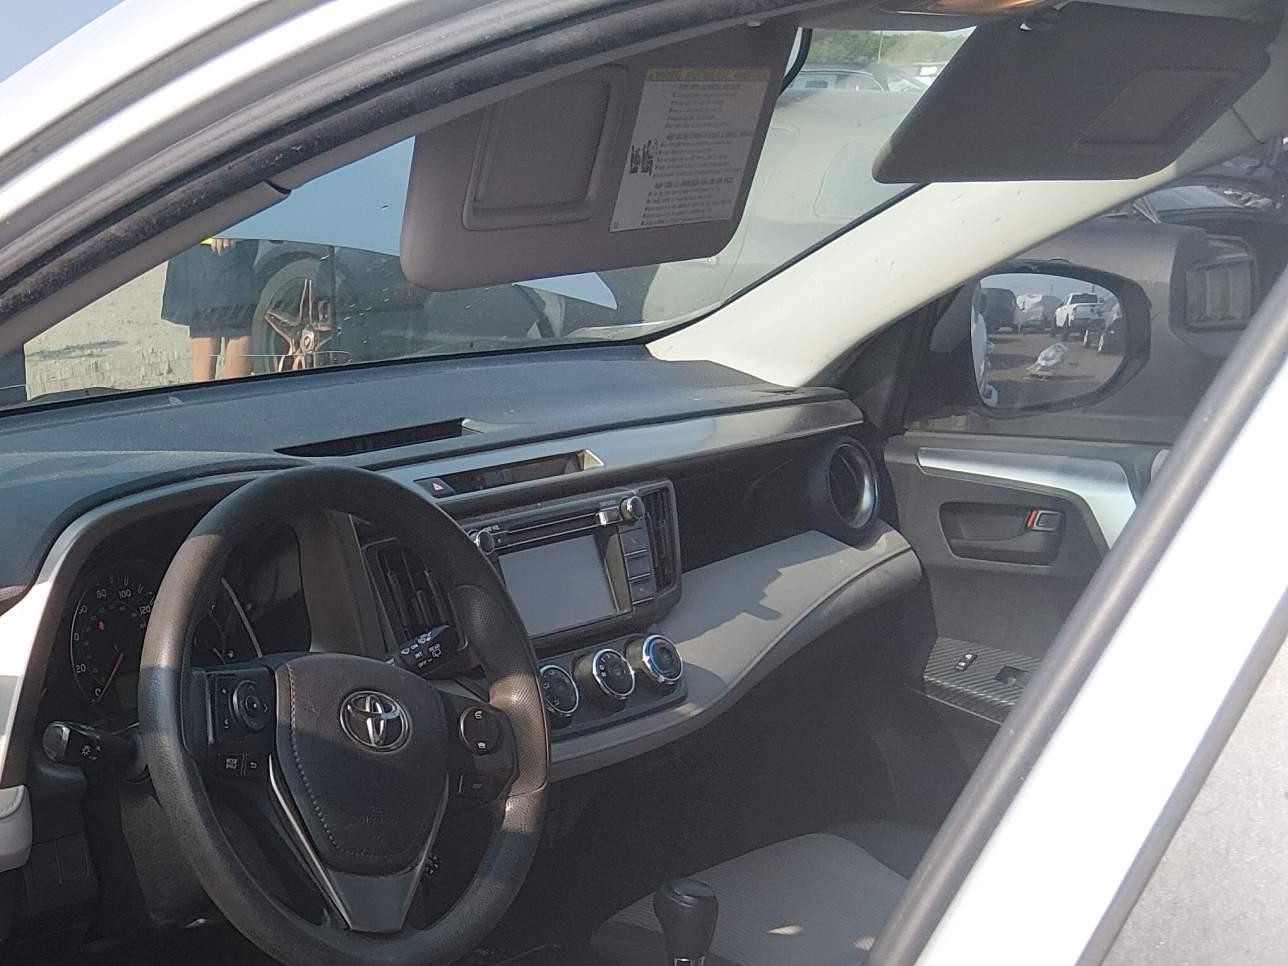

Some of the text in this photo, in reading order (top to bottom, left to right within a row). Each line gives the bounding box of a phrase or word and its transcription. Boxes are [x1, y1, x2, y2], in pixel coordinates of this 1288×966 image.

[118, 589, 132, 599] 100
[140, 605, 151, 616] 120
[75, 664, 87, 674] 20
